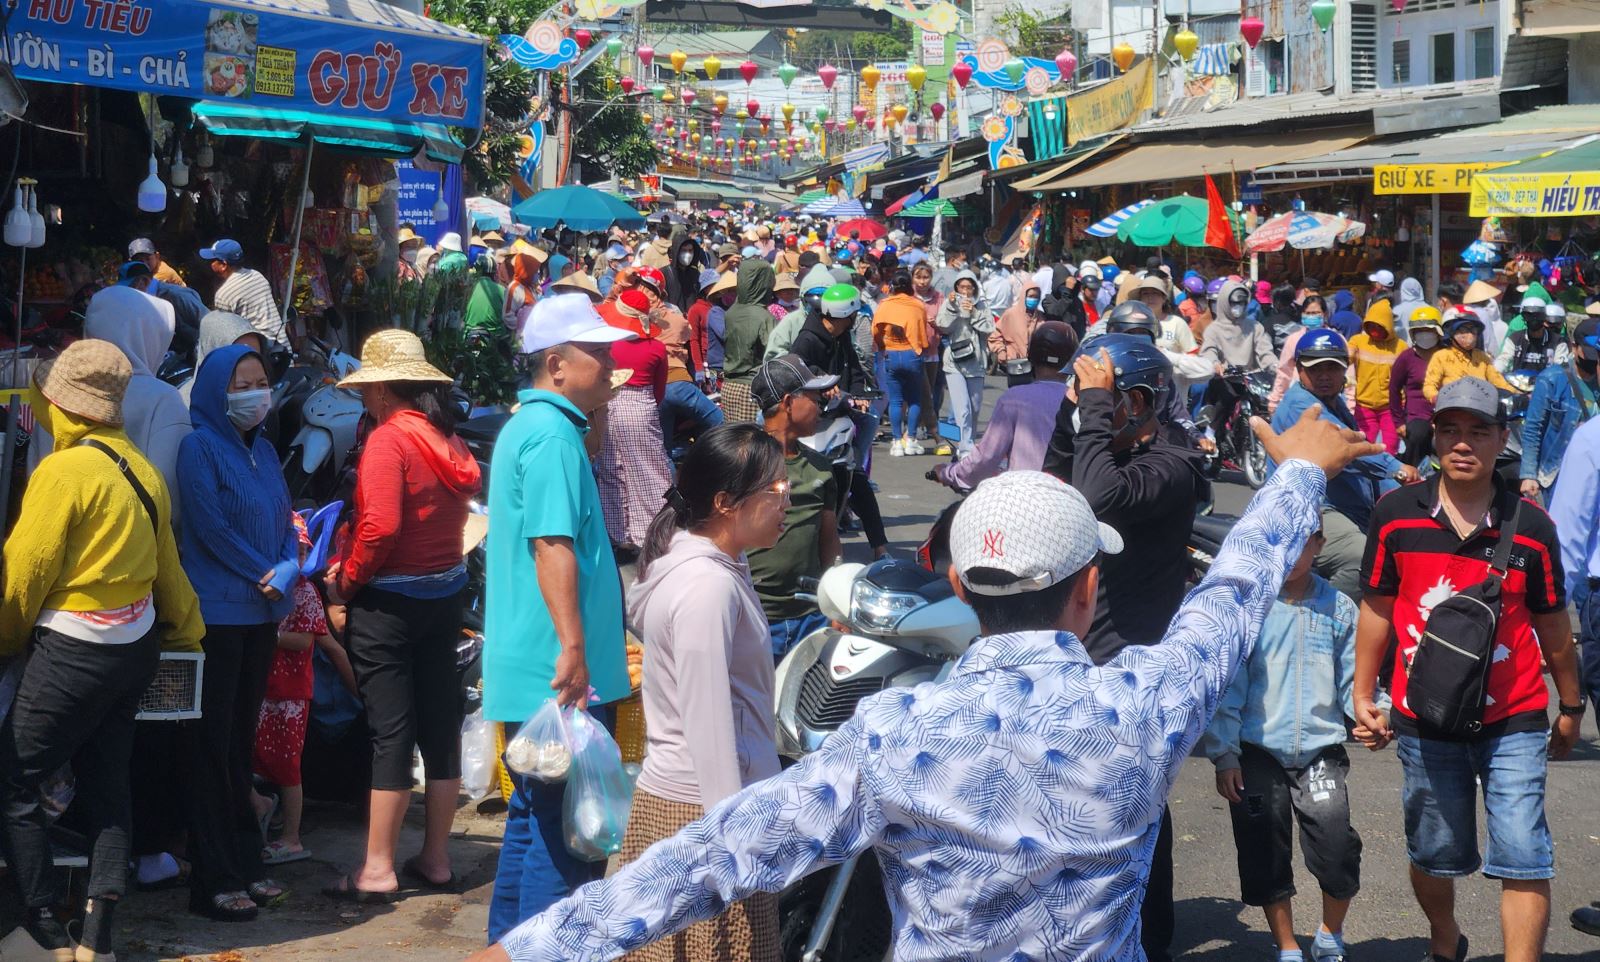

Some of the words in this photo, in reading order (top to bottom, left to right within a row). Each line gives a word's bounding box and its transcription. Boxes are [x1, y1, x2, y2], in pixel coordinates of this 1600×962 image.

[0, 32, 60, 72] ƯỜN
[87, 43, 114, 79] BÌ
[139, 50, 190, 88] CHẢ
[308, 41, 402, 111] GIỮ
[409, 62, 468, 119] XE
[1413, 169, 1436, 188] XE
[1541, 174, 1580, 213] HIẾU
